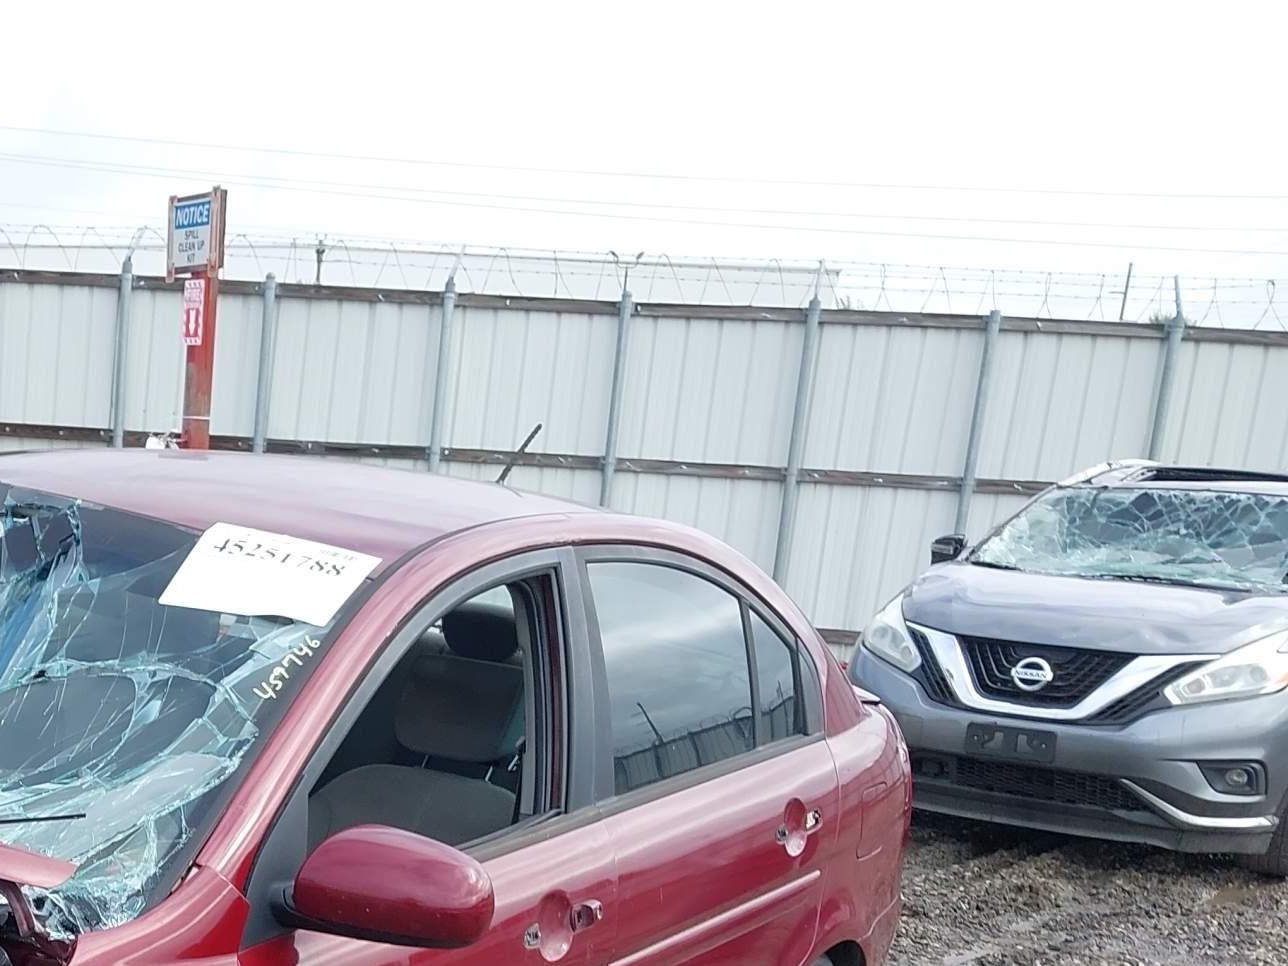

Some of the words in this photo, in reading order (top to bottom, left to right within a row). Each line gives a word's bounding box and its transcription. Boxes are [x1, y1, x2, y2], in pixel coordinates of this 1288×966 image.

[176, 204, 209, 227] NOTICE
[185, 230, 198, 240] SPILL
[178, 241, 195, 252] CLEAN
[197, 239, 205, 250] UP
[187, 253, 195, 263] KIT
[213, 538, 346, 576] 45251788
[1014, 669, 1048, 679] NISSAN
